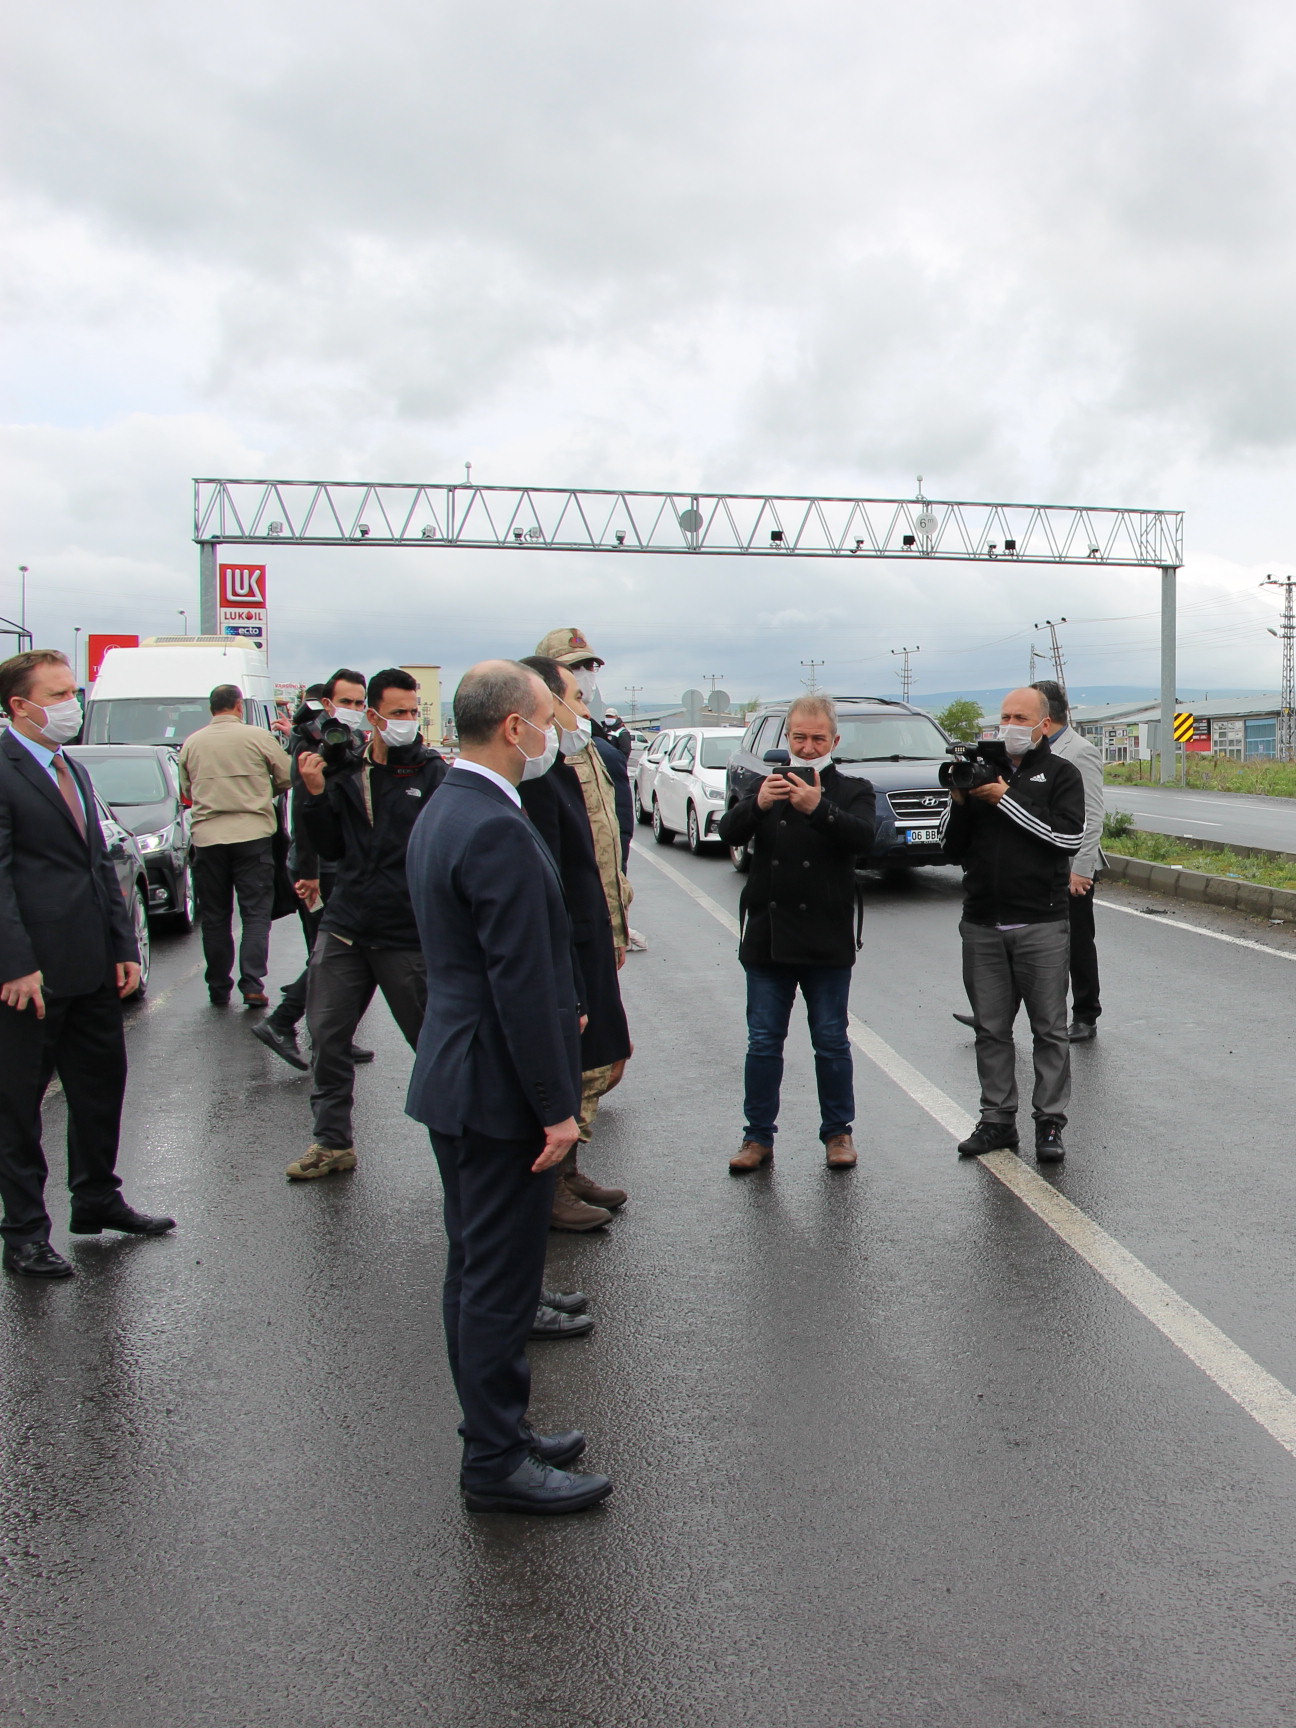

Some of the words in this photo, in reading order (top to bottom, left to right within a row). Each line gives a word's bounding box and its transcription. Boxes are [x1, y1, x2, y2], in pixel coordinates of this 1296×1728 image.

[226, 569, 264, 602] LUK
[224, 611, 263, 621] LUKOIL
[238, 626, 260, 635] ecto
[911, 831, 922, 840] 06
